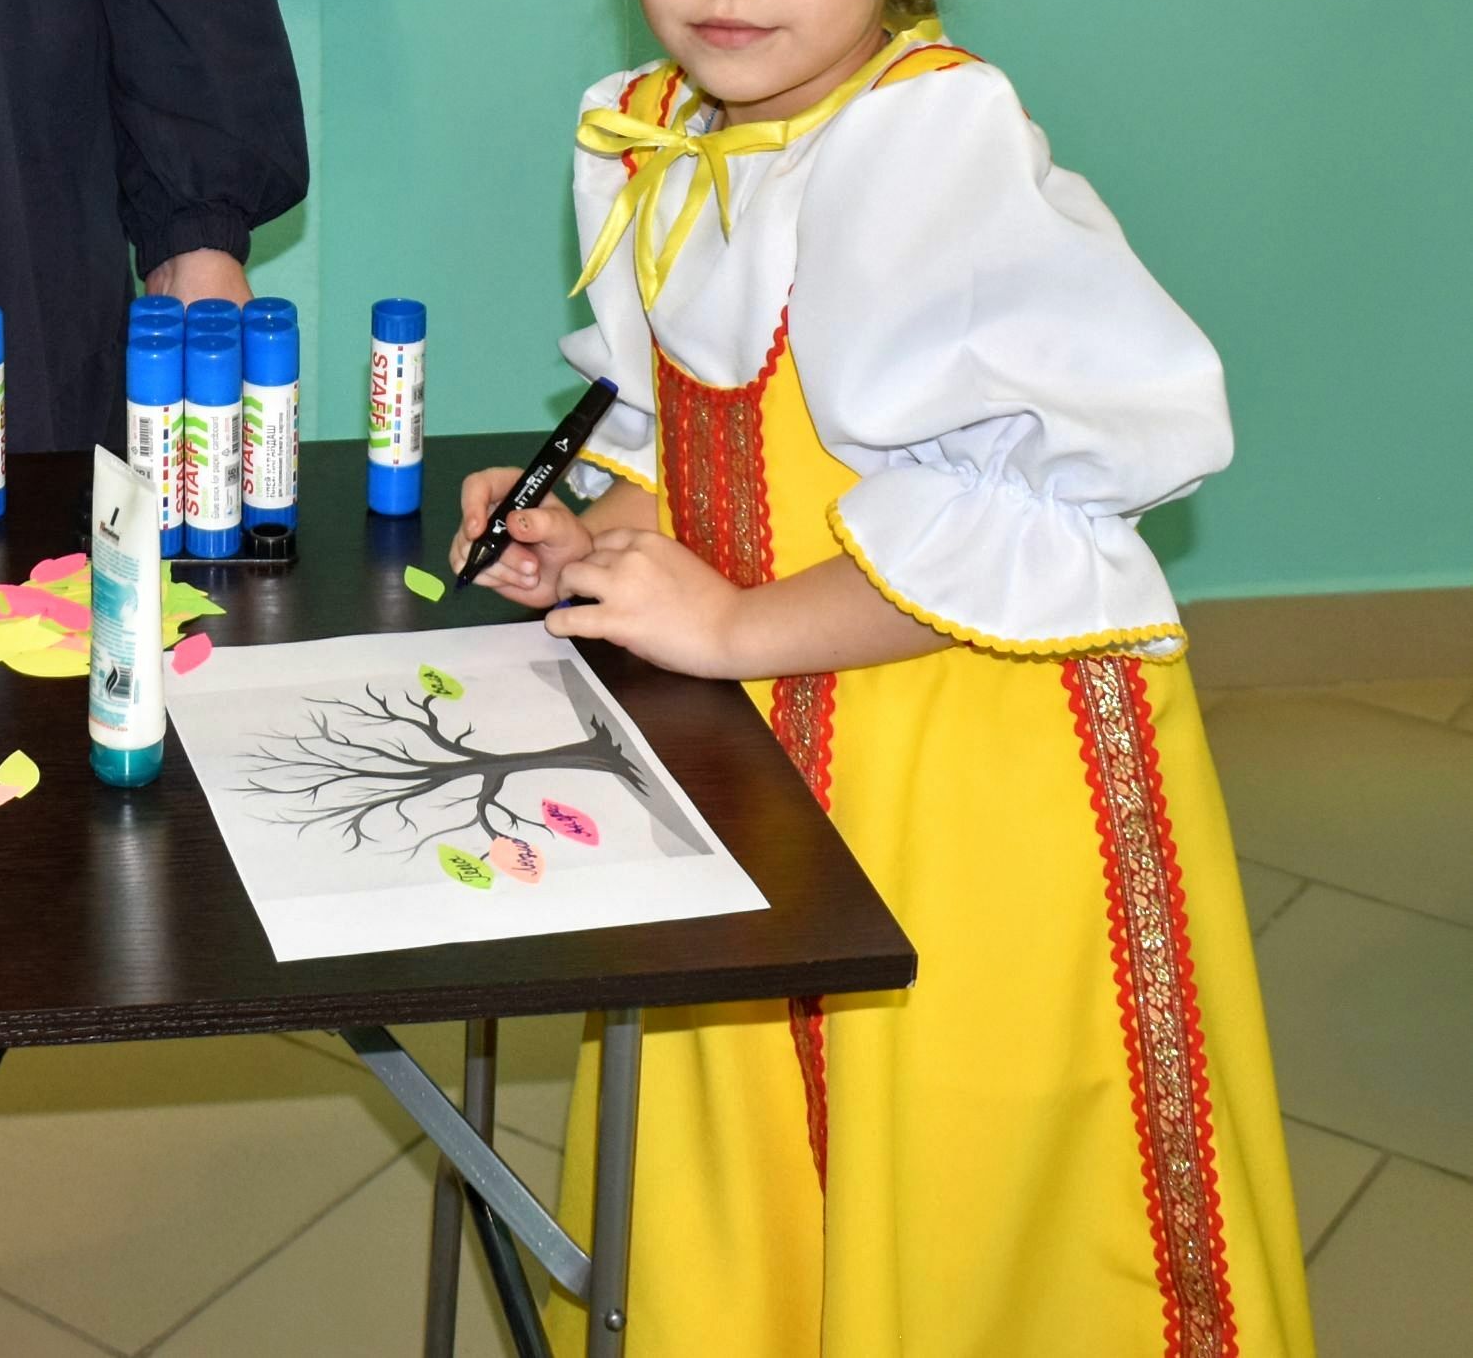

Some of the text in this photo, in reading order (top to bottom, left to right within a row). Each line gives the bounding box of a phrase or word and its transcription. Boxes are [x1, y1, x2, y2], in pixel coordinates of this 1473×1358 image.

[372, 351, 388, 428] STAFF
[186, 440, 199, 516] STAFF
[243, 419, 254, 495] STAFF
[528, 464, 553, 496] MARKER
